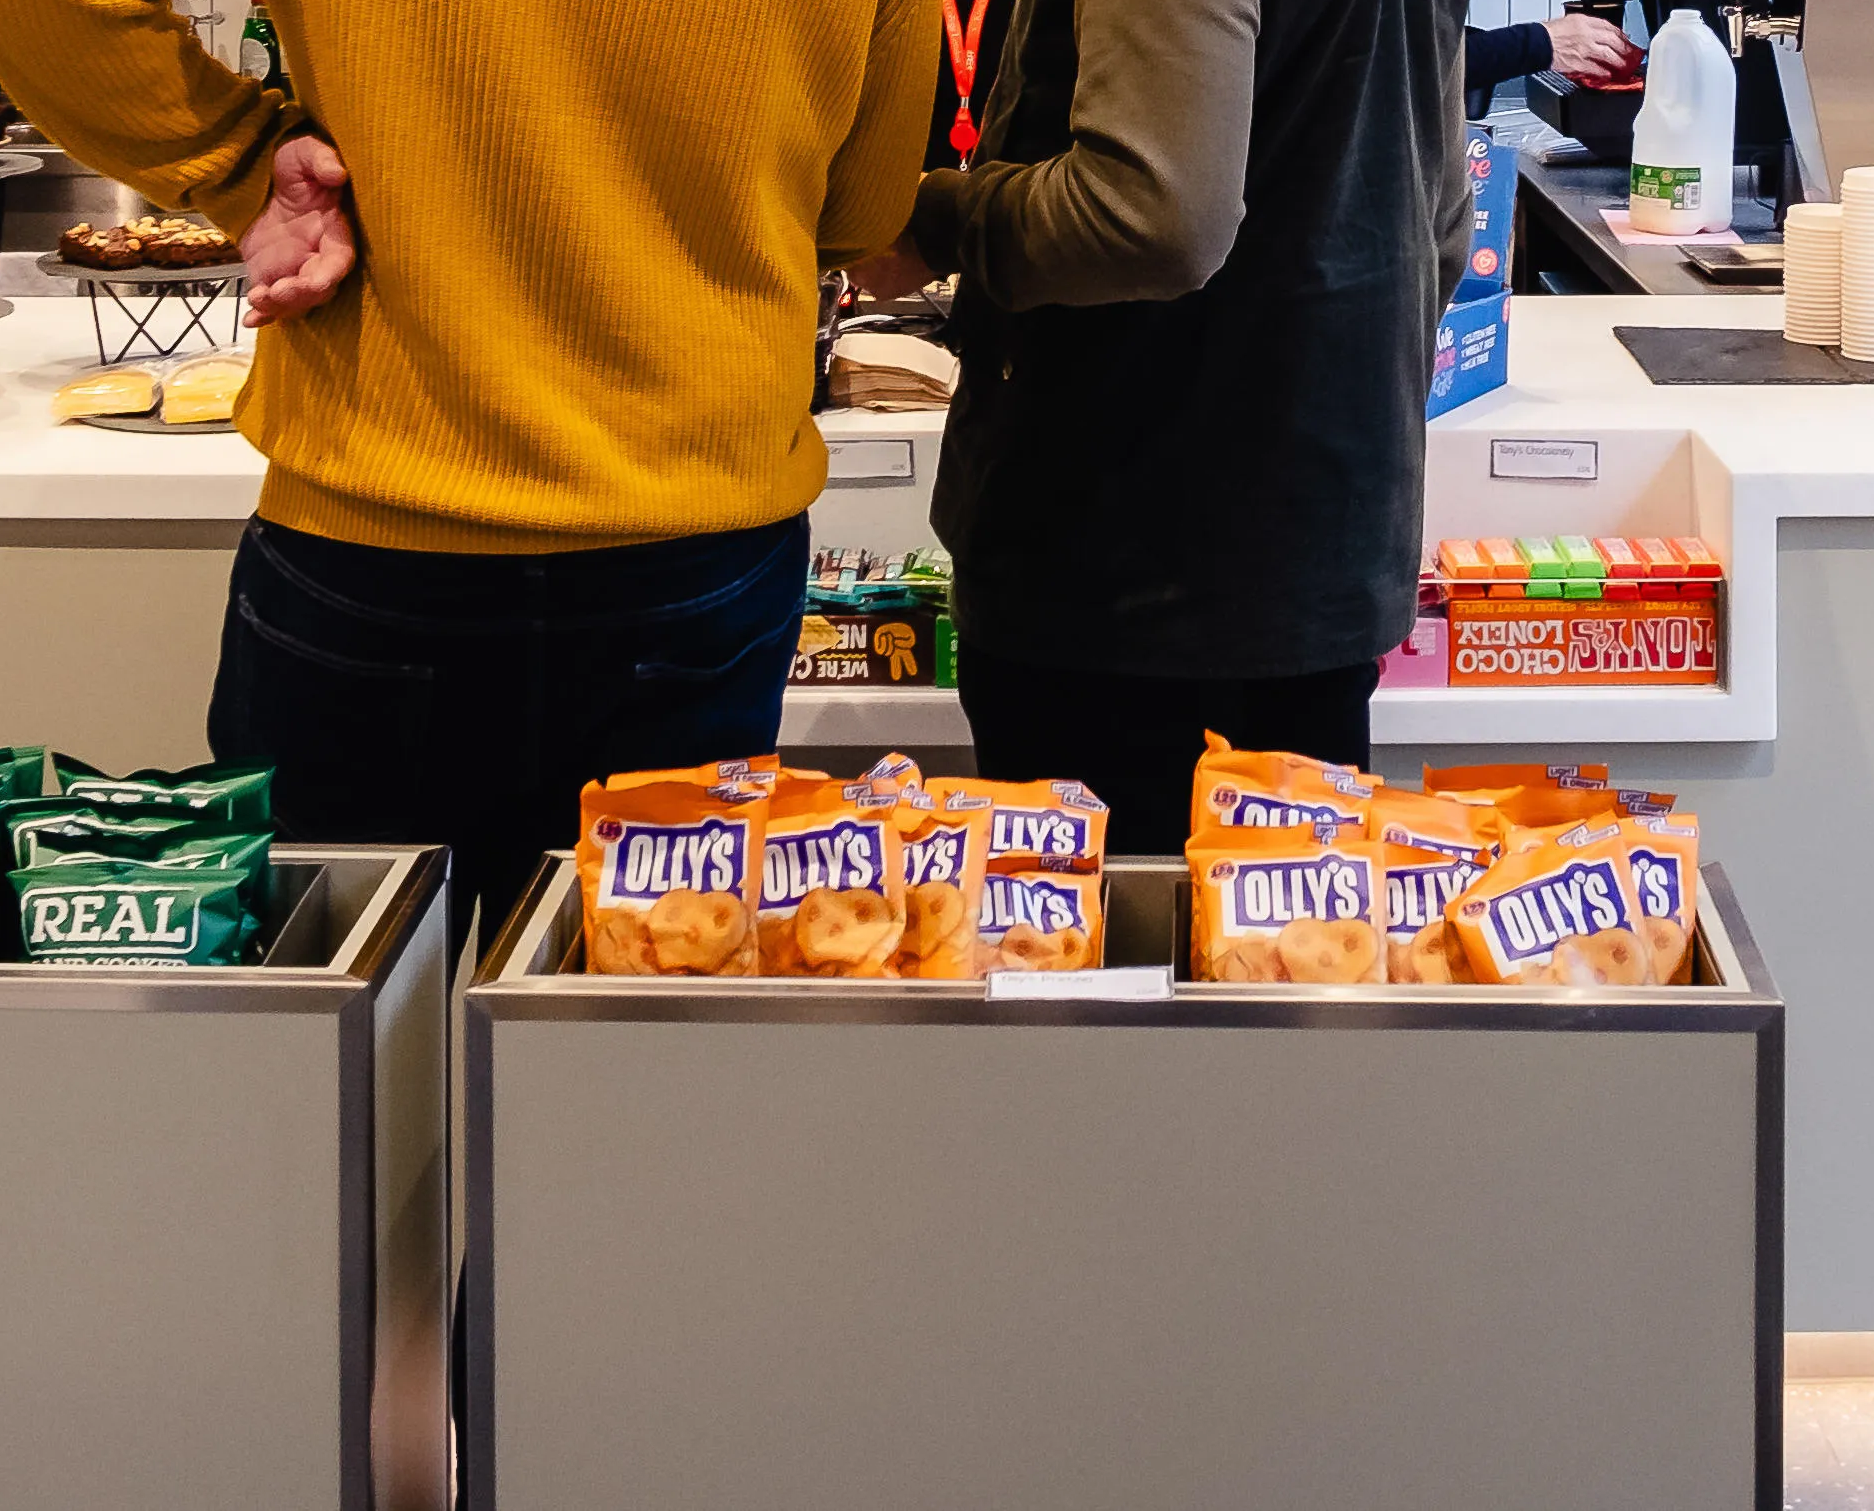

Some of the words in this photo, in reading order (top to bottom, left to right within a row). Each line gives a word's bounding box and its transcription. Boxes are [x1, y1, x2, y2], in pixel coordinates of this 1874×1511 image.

[1458, 620, 1563, 646] LONELY
[1568, 617, 1717, 673] TONY'S
[1455, 648, 1566, 675] CHOCO
[624, 827, 735, 894] OLLY'S
[992, 813, 1076, 858] LLY'S
[763, 828, 874, 903] OLLY'S
[1244, 861, 1361, 923] OLLY'S
[29, 894, 187, 944] REAL
[1498, 871, 1619, 952] OLLY'S
